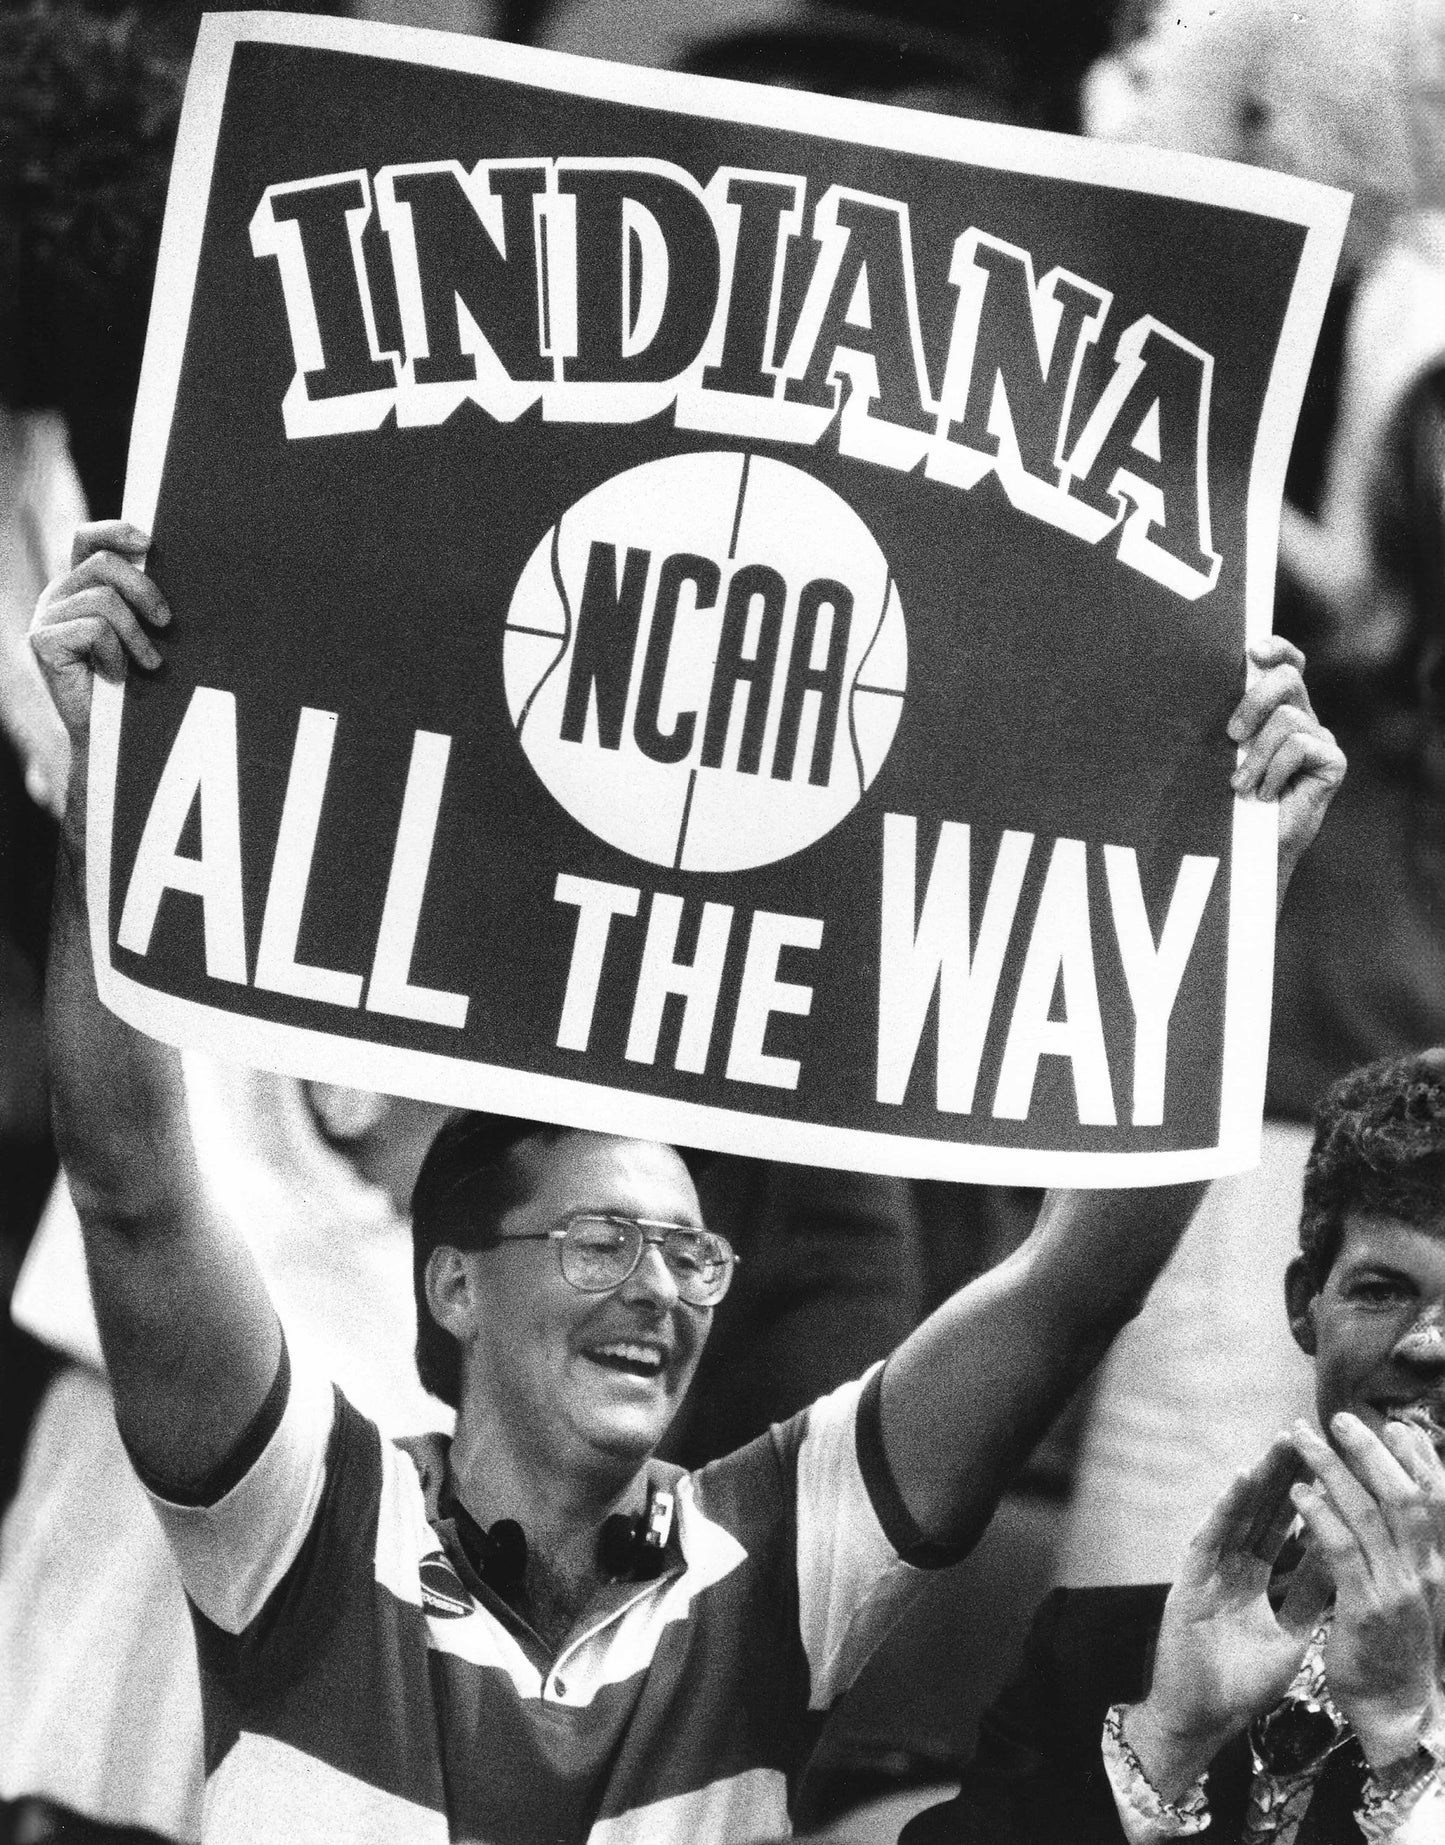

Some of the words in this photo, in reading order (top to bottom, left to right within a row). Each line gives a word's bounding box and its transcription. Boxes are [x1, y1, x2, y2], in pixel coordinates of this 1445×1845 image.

[250, 156, 1223, 601] INDIANA
[560, 541, 856, 788] NCAA
[117, 686, 470, 1029] ALL
[553, 873, 824, 1089] THE
[878, 812, 1220, 1128] WAY
